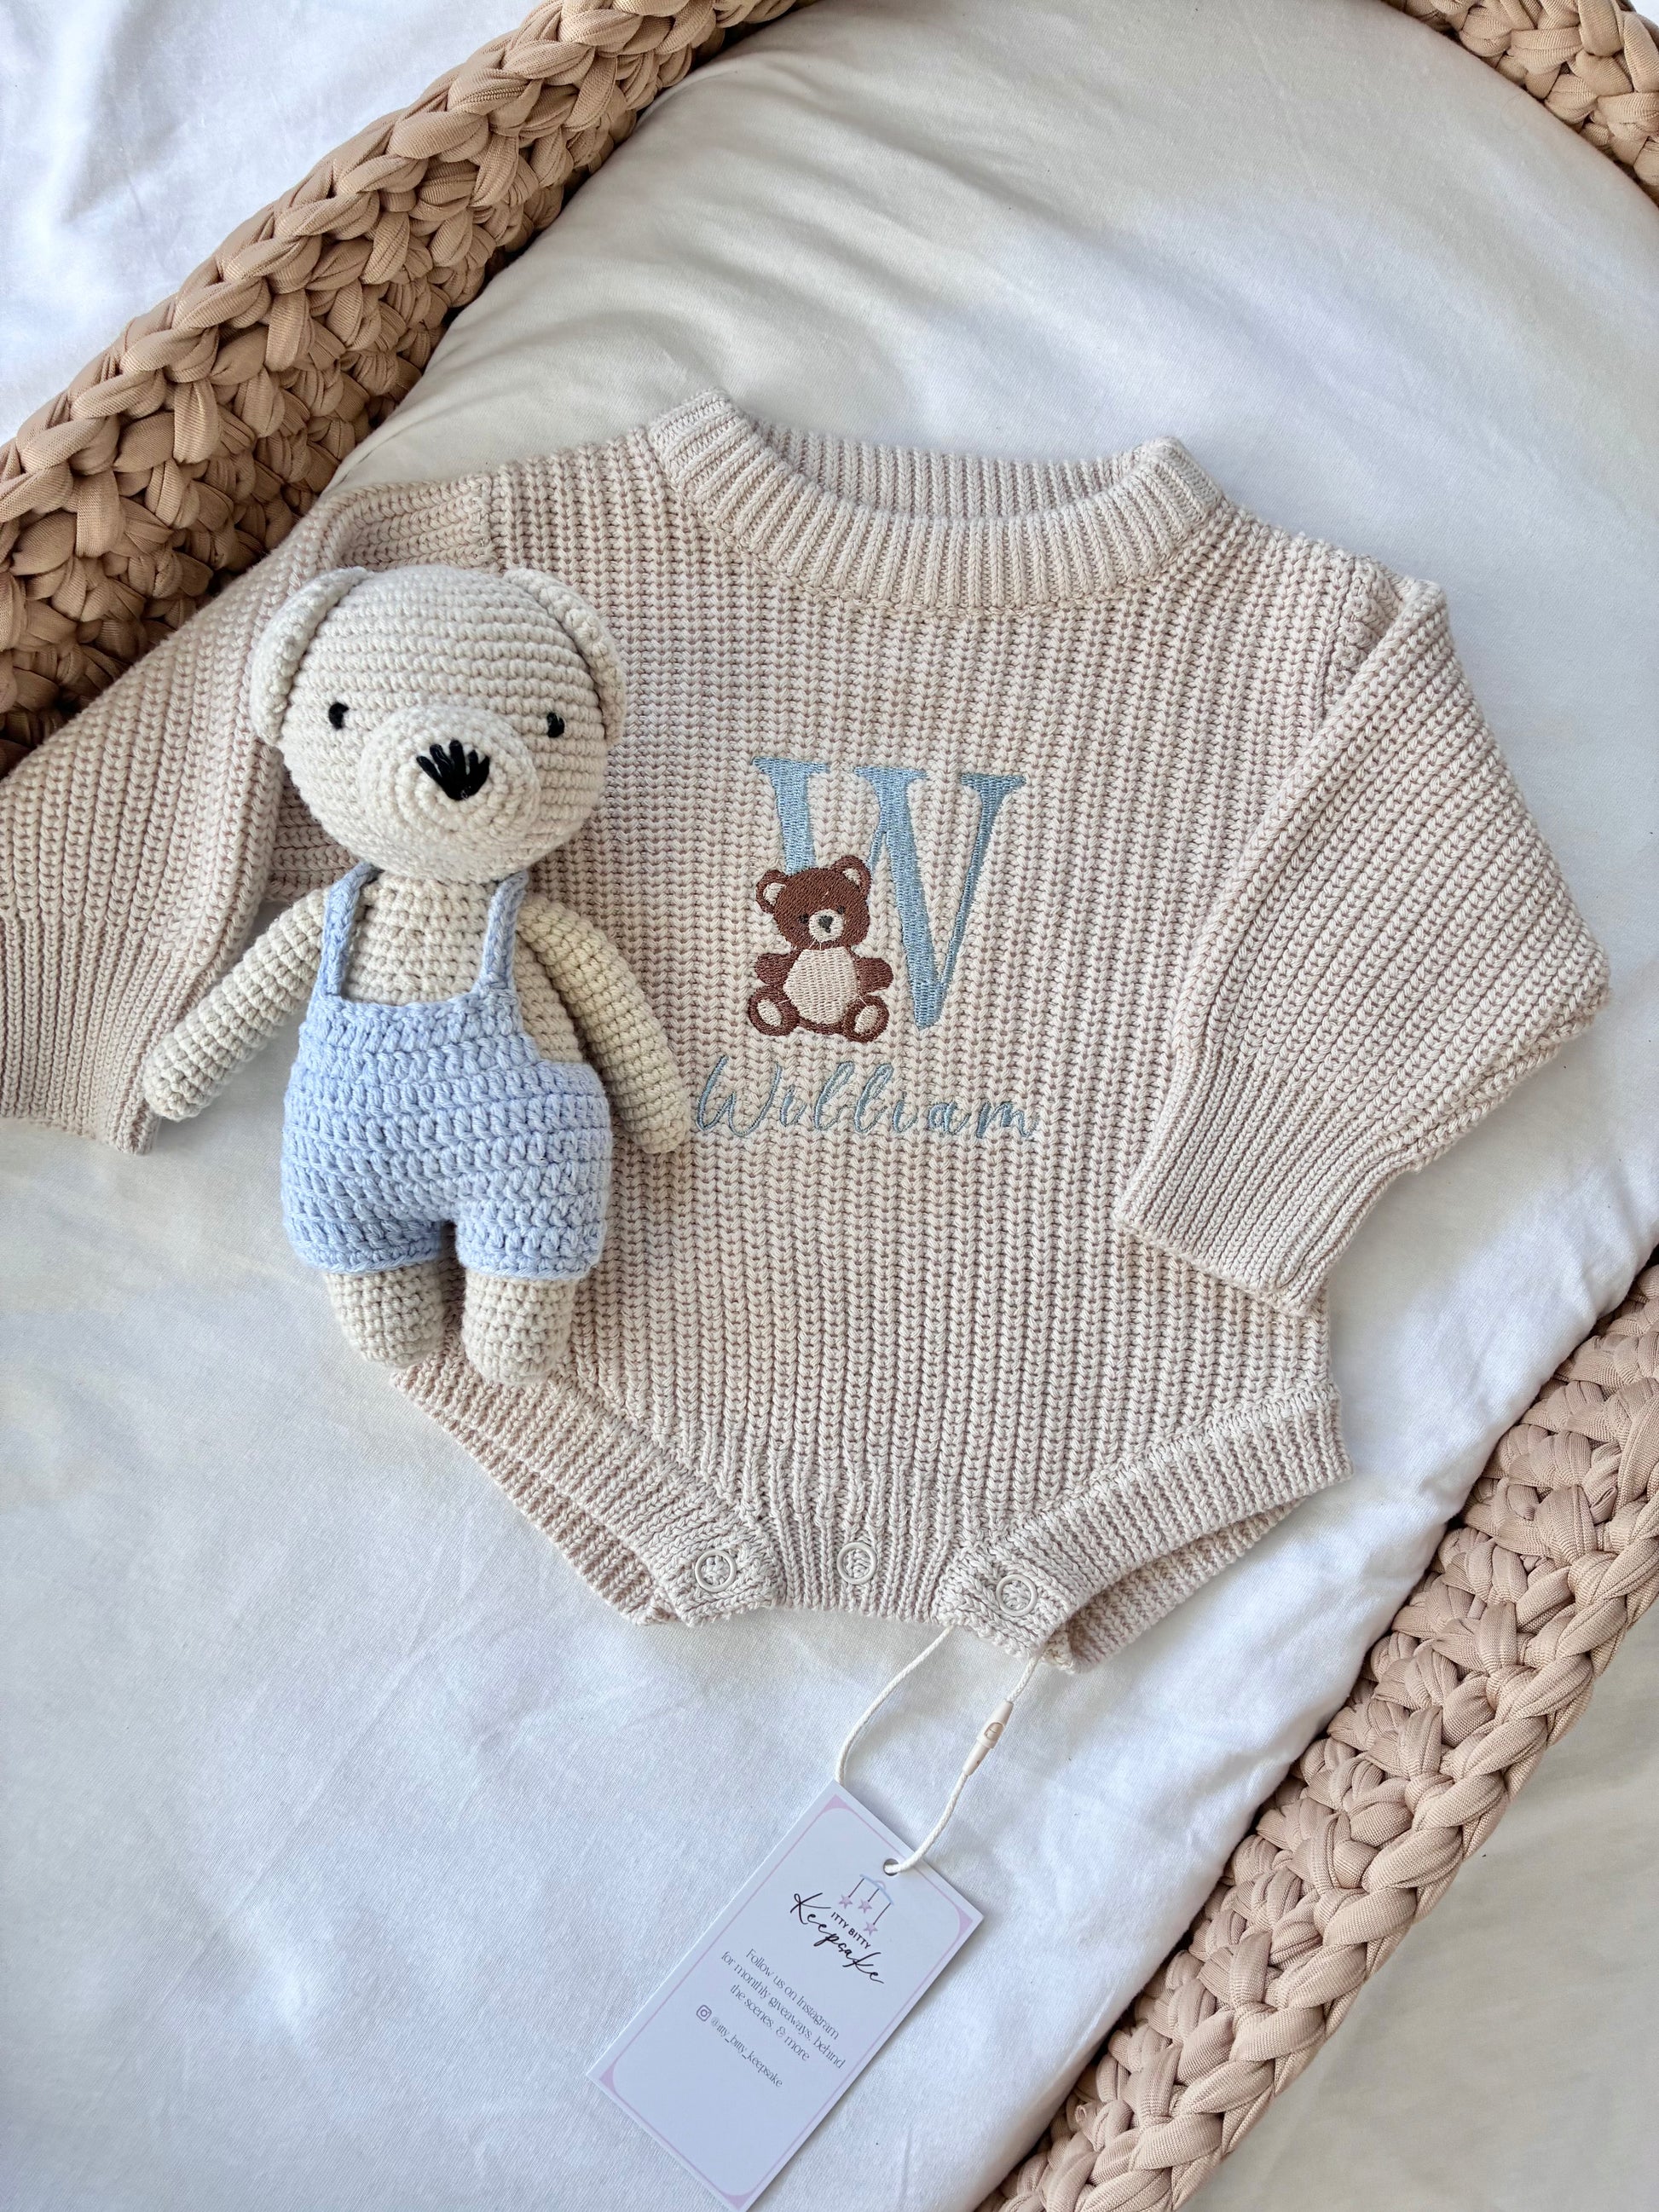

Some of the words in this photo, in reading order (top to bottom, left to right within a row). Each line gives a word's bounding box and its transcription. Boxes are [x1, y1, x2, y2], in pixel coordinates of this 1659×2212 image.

[751, 756, 1026, 1031] W
[696, 1054, 1040, 1138] William
[789, 1892, 885, 1984] Keepsake
[830, 1911, 848, 1930] ITTY
[848, 1927, 871, 1949] BITTY
[721, 1950, 736, 1967] for
[734, 1963, 771, 1999] monthly
[812, 2035, 846, 2069] behind
[730, 1984, 746, 2003] the
[775, 2025, 787, 2038] &
[784, 2036, 811, 2061] more
[746, 1949, 772, 1978] Follow
[772, 1975, 785, 1990] us
[784, 1985, 797, 2001] on
[796, 1993, 840, 2040] Instagram
[711, 2015, 783, 2088] @itty_bitty_keepsake
